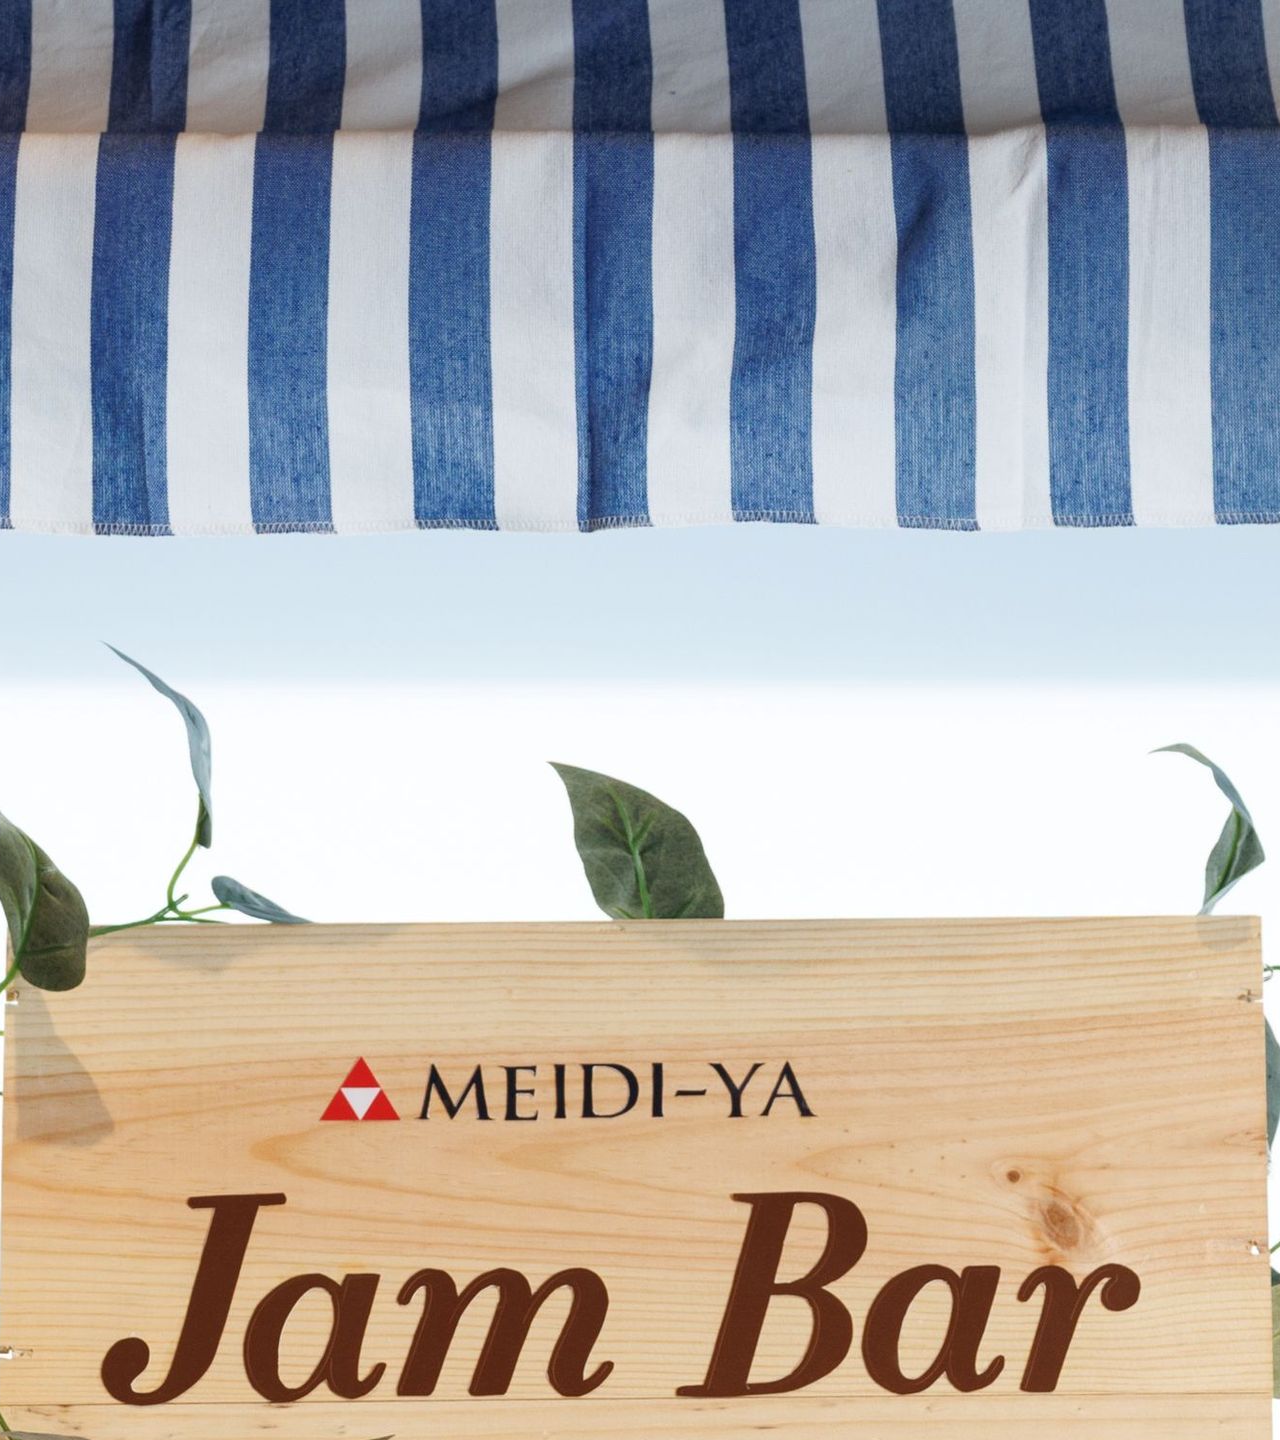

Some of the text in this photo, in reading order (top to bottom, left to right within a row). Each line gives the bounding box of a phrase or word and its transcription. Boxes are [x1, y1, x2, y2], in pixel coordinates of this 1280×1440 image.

[414, 1060, 819, 1122] MEIDI-YA
[100, 1188, 1145, 1409] Jam Bar
